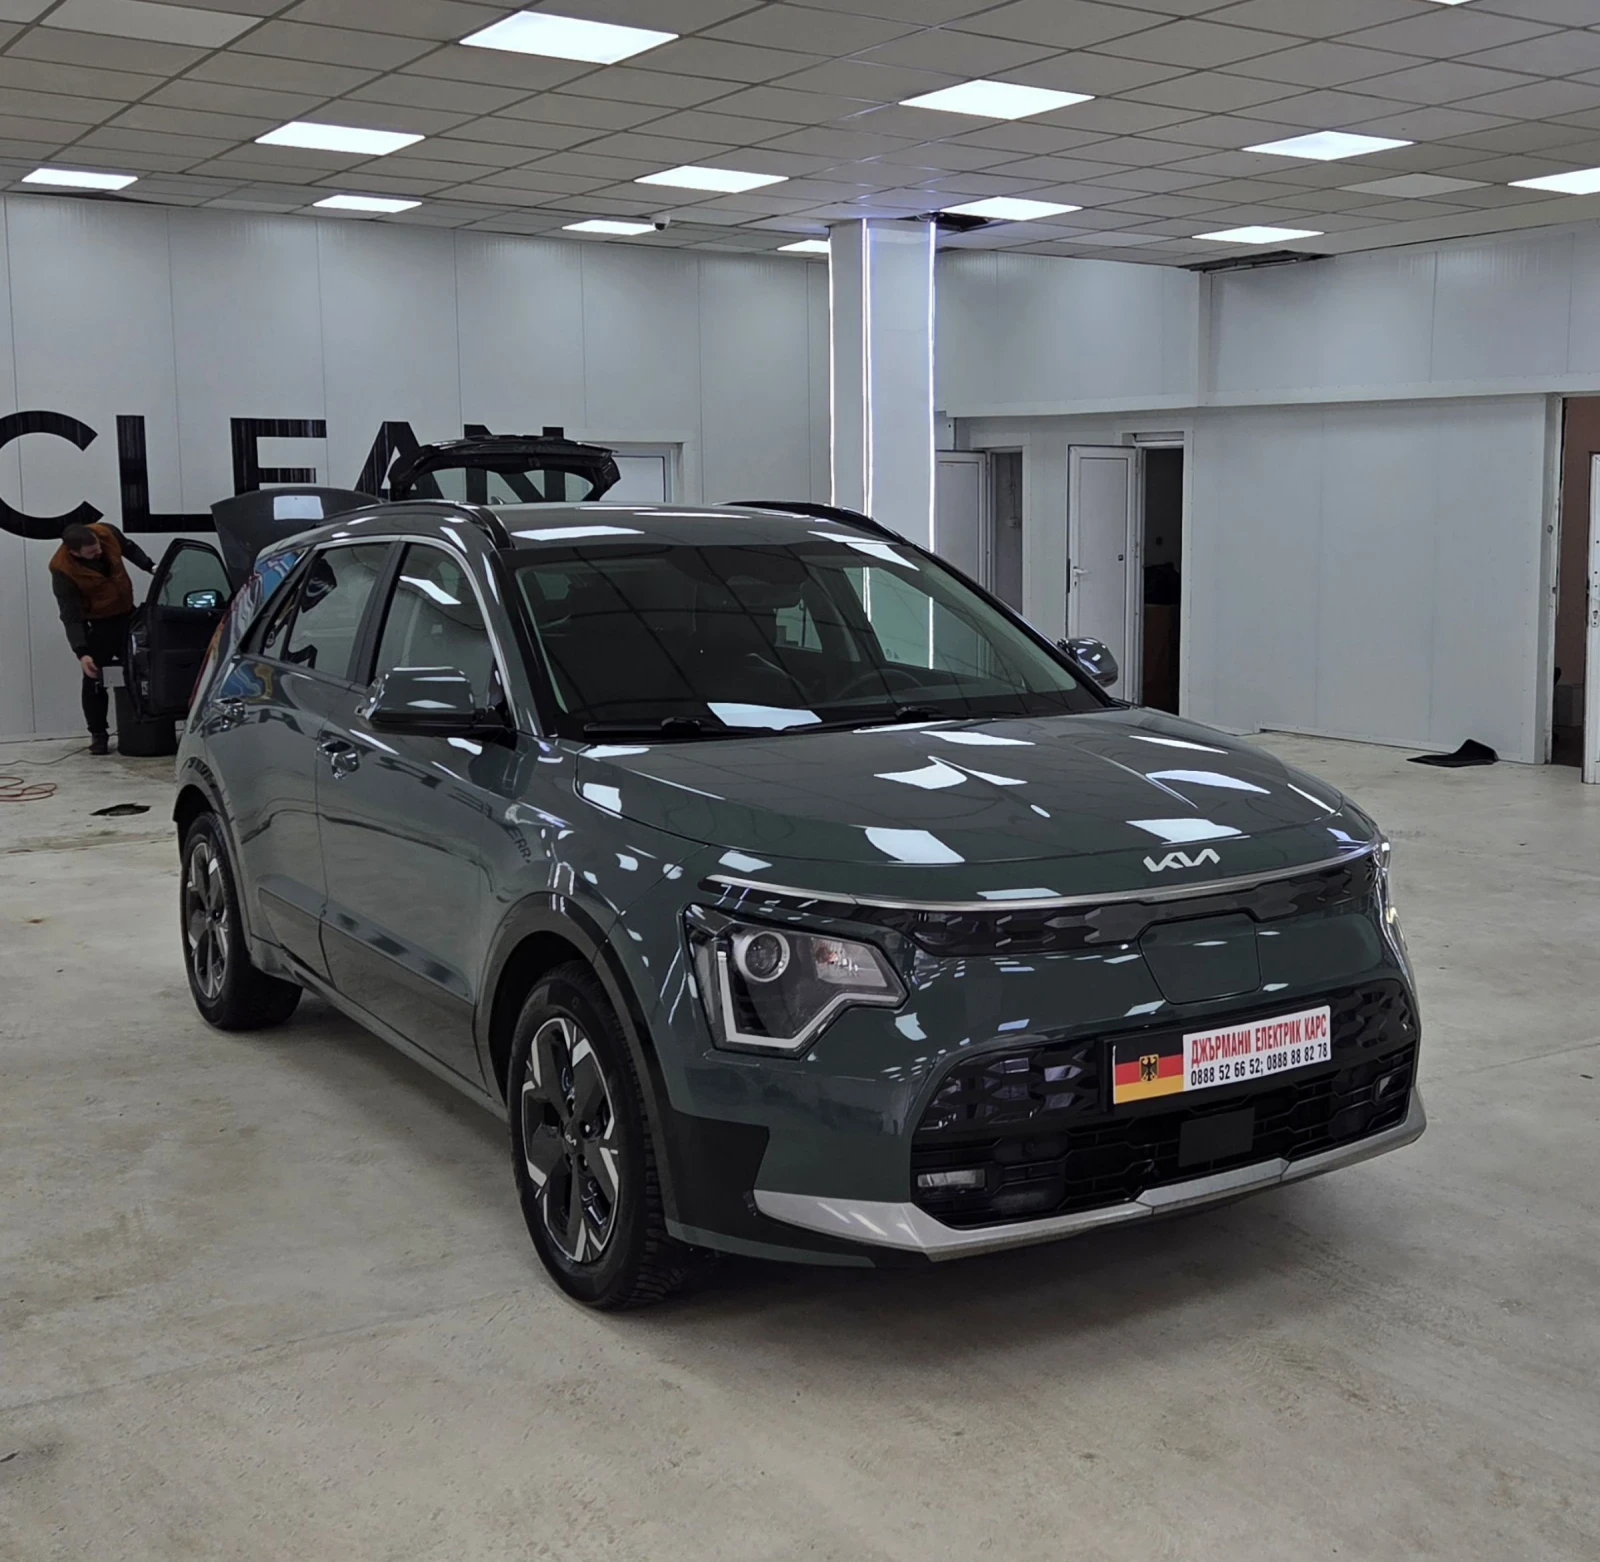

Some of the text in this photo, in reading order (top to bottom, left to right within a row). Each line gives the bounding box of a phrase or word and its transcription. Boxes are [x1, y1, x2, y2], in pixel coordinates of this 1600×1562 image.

[1143, 848, 1221, 873] KIA
[1191, 1013, 1327, 1069] ДЖЪРМАНИ ЕЛЕКТРИК КАРС
[1191, 1042, 1328, 1086] 0888 52 66 52; 0888 88 82 78
